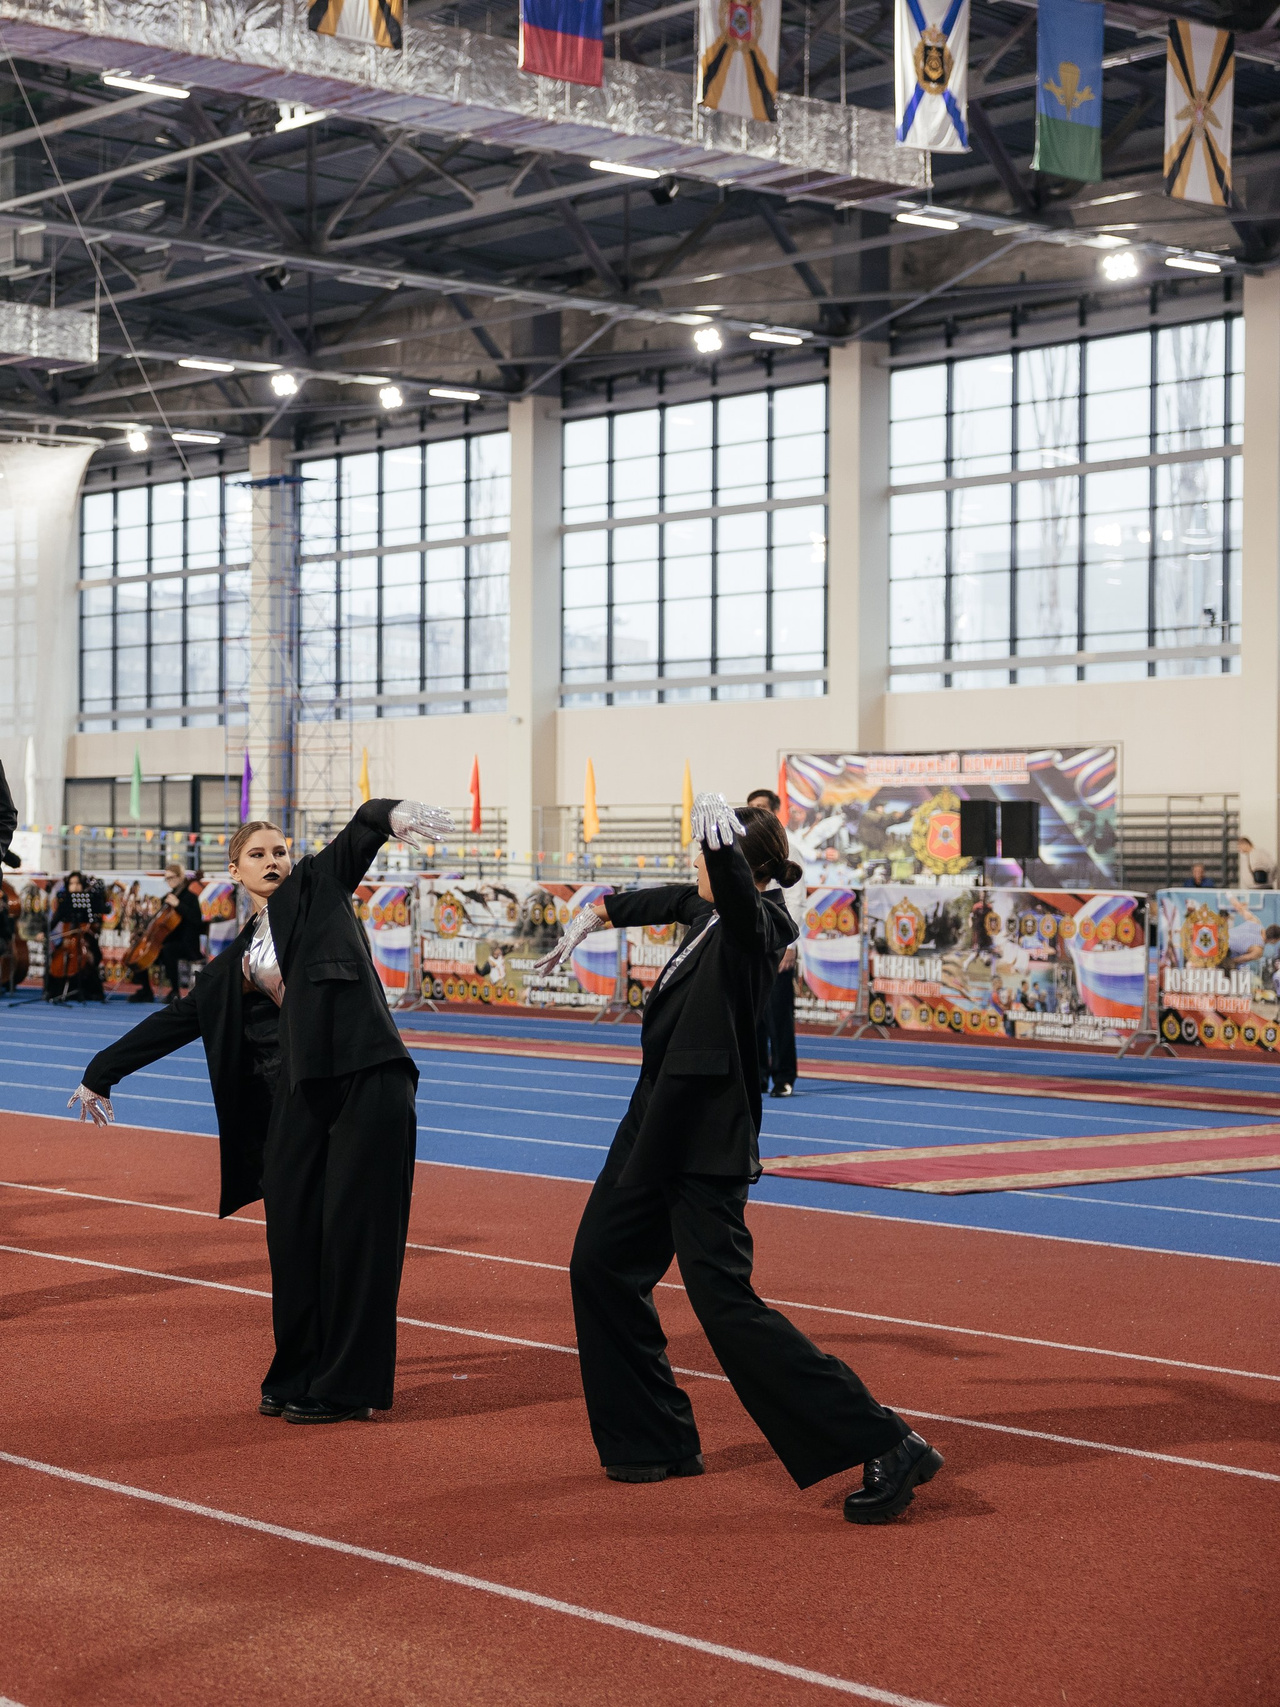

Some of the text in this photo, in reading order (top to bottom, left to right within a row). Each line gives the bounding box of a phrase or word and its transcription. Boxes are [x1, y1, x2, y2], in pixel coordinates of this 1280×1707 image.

[866, 753, 1028, 773] СПОРТИВНЫЙ КОМИТЕТ
[423, 938, 476, 964] ЮЖНЫЙ
[873, 954, 942, 982] ЮЖНЫЙ
[1164, 966, 1251, 994] ЮЖНЫЙ
[1217, 997, 1251, 1013] ОКРУГ
